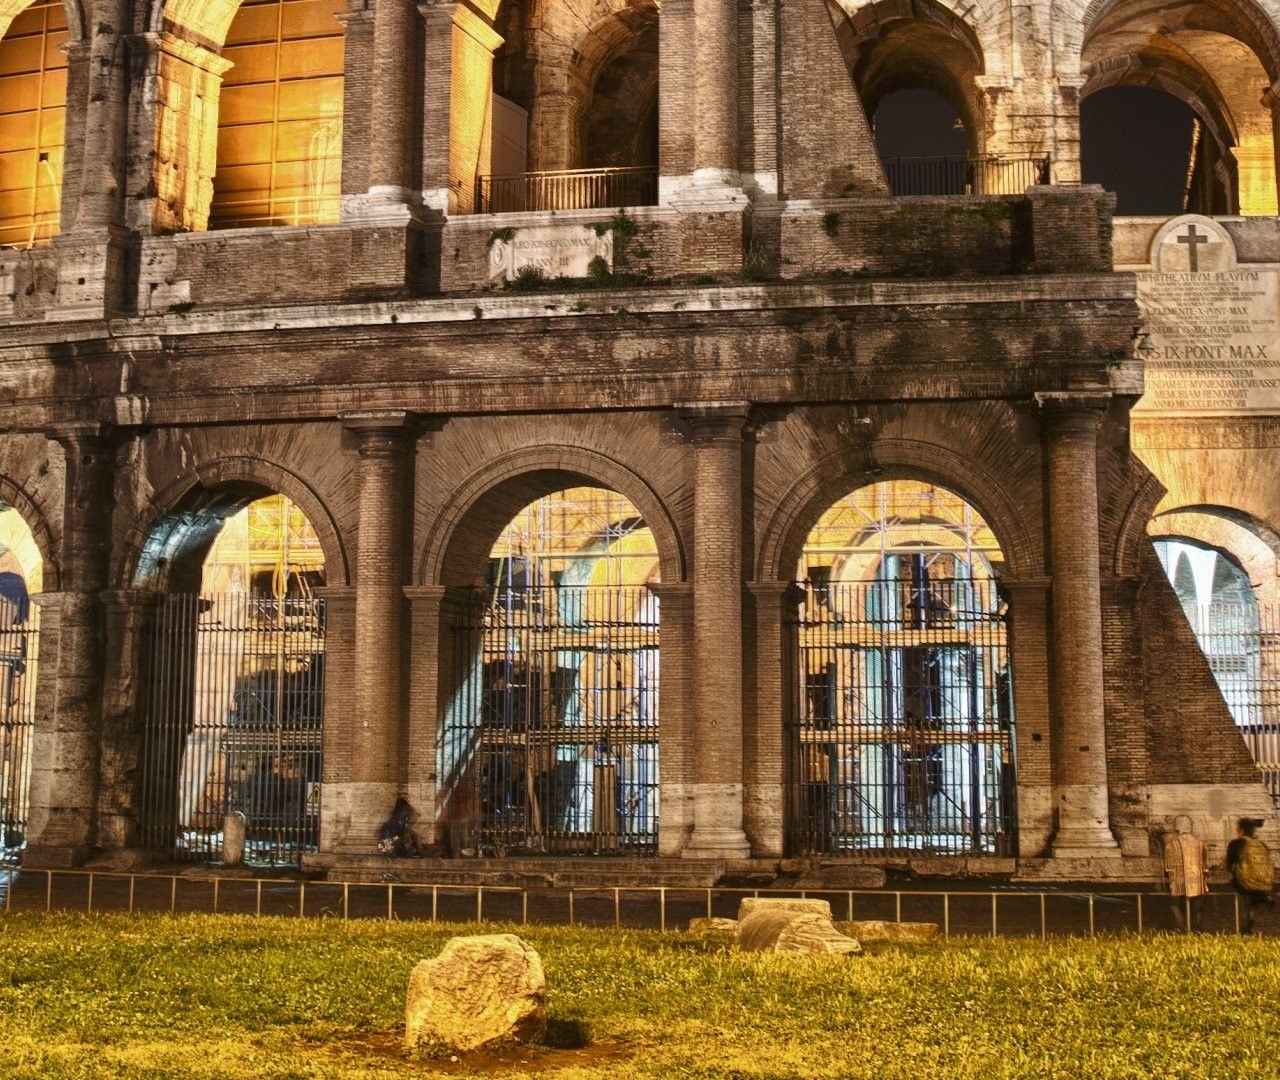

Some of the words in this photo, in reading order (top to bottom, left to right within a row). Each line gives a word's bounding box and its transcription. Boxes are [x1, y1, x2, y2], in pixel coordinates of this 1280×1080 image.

[1215, 272, 1259, 281] FLAVIVM
[1207, 306, 1226, 315] PONT
[1229, 306, 1249, 315] MAX
[1233, 325, 1252, 333] MAX
[1164, 345, 1182, 359] IX
[1185, 345, 1224, 359] PONT
[1230, 345, 1268, 359] MAX
[1155, 390, 1202, 399] MEMORIAM
[1153, 399, 1175, 408] ANNO
